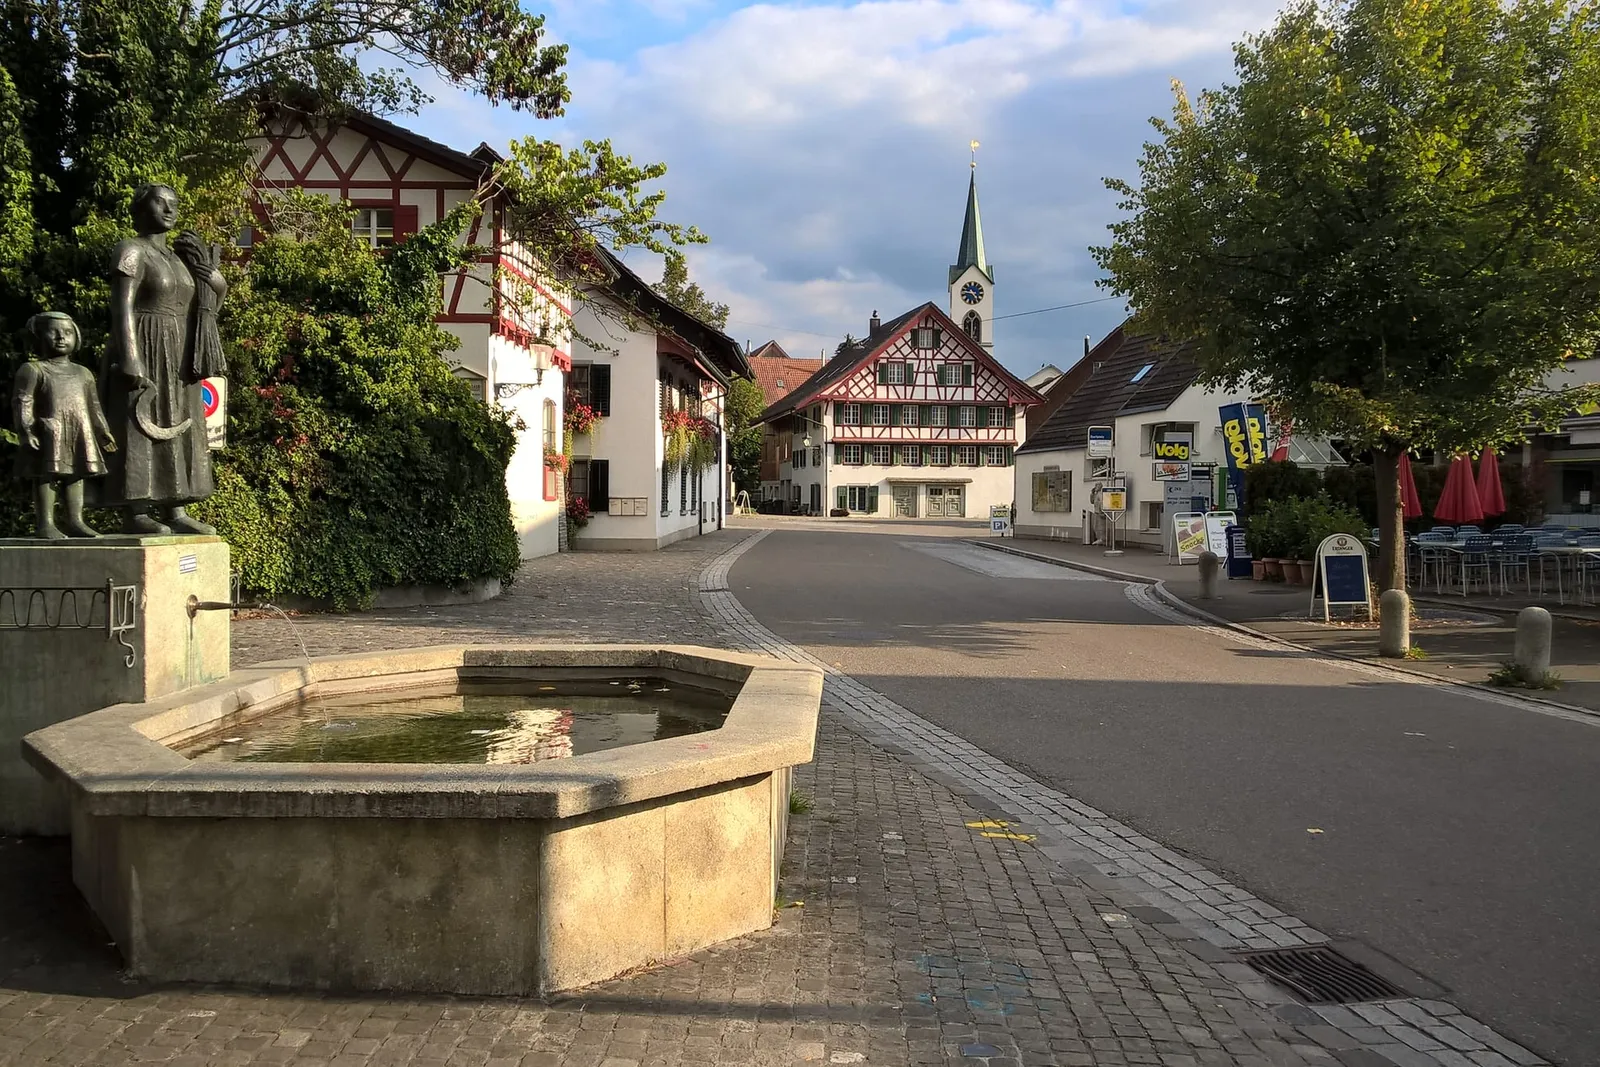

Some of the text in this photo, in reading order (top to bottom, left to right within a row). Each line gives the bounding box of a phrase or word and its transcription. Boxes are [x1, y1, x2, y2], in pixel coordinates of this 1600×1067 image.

[1156, 444, 1189, 459] Volg
[1225, 419, 1248, 469] Volg
[1180, 537, 1204, 552] Snacks
